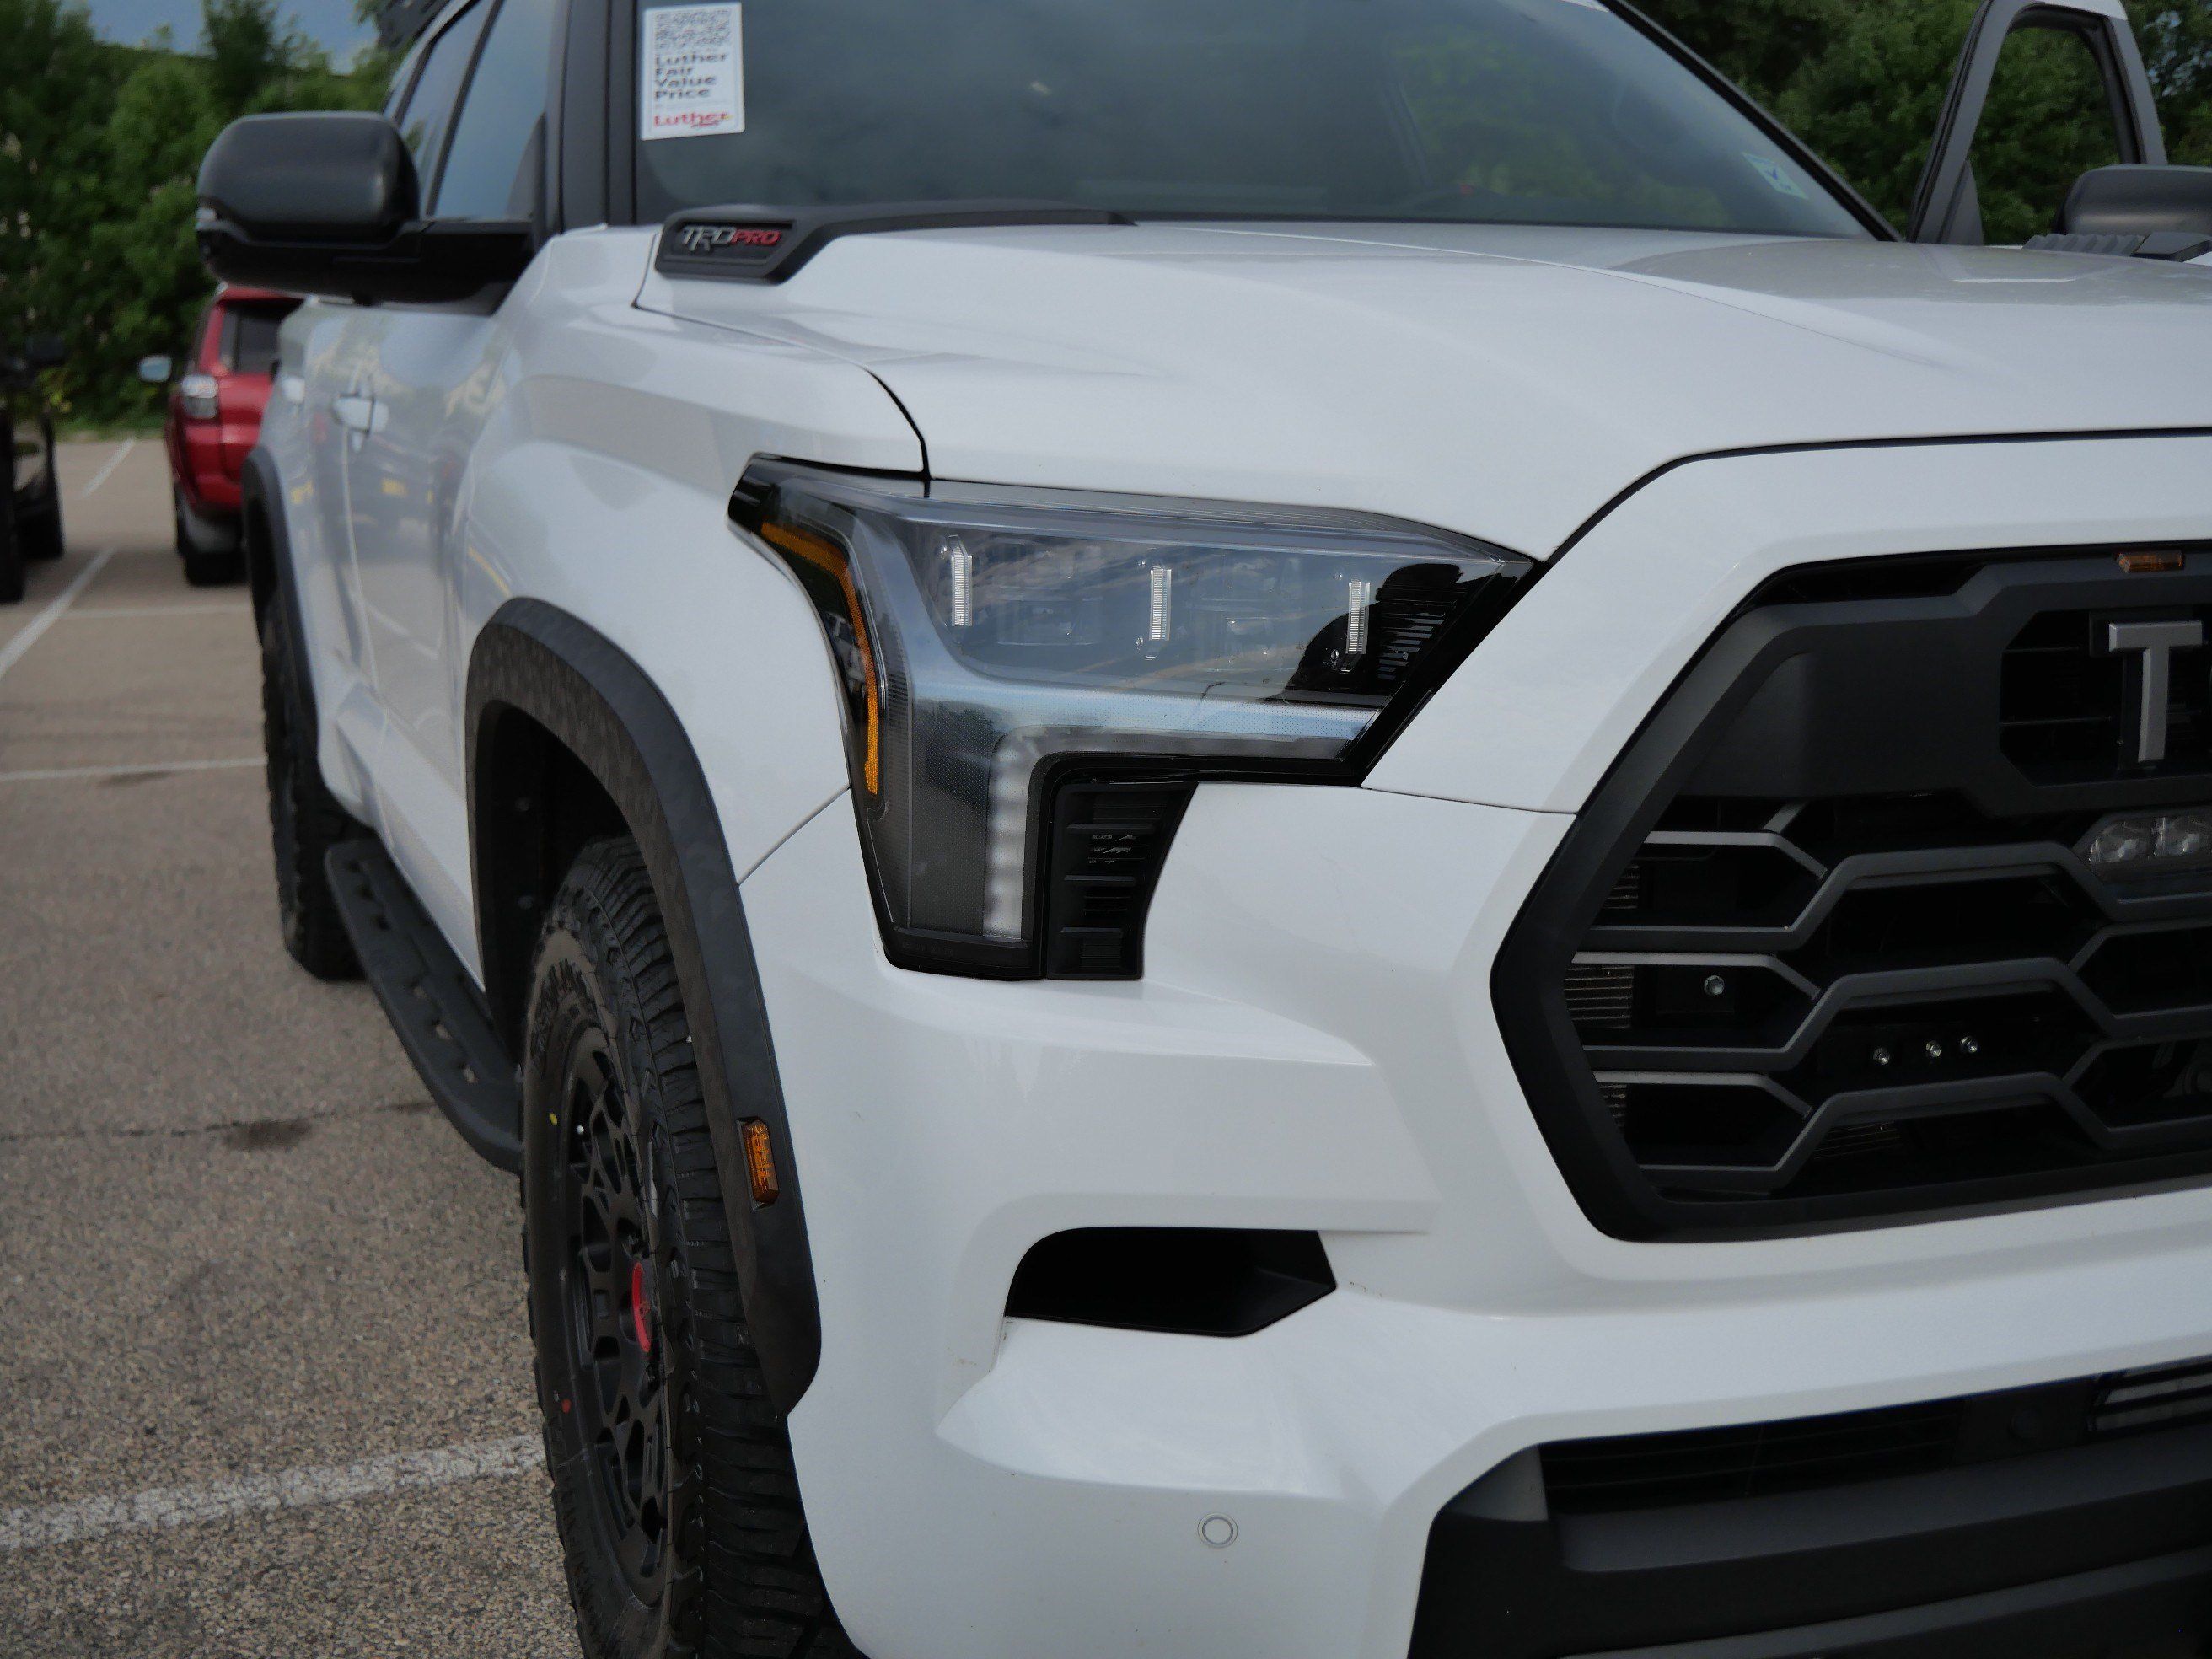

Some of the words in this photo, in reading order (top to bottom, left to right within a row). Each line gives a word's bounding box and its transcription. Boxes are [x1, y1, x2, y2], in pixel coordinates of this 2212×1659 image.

[655, 53, 728, 65] Luther
[655, 67, 693, 77] Fair
[655, 77, 717, 87] Value
[655, 89, 710, 100] Price
[652, 111, 729, 126] Luther
